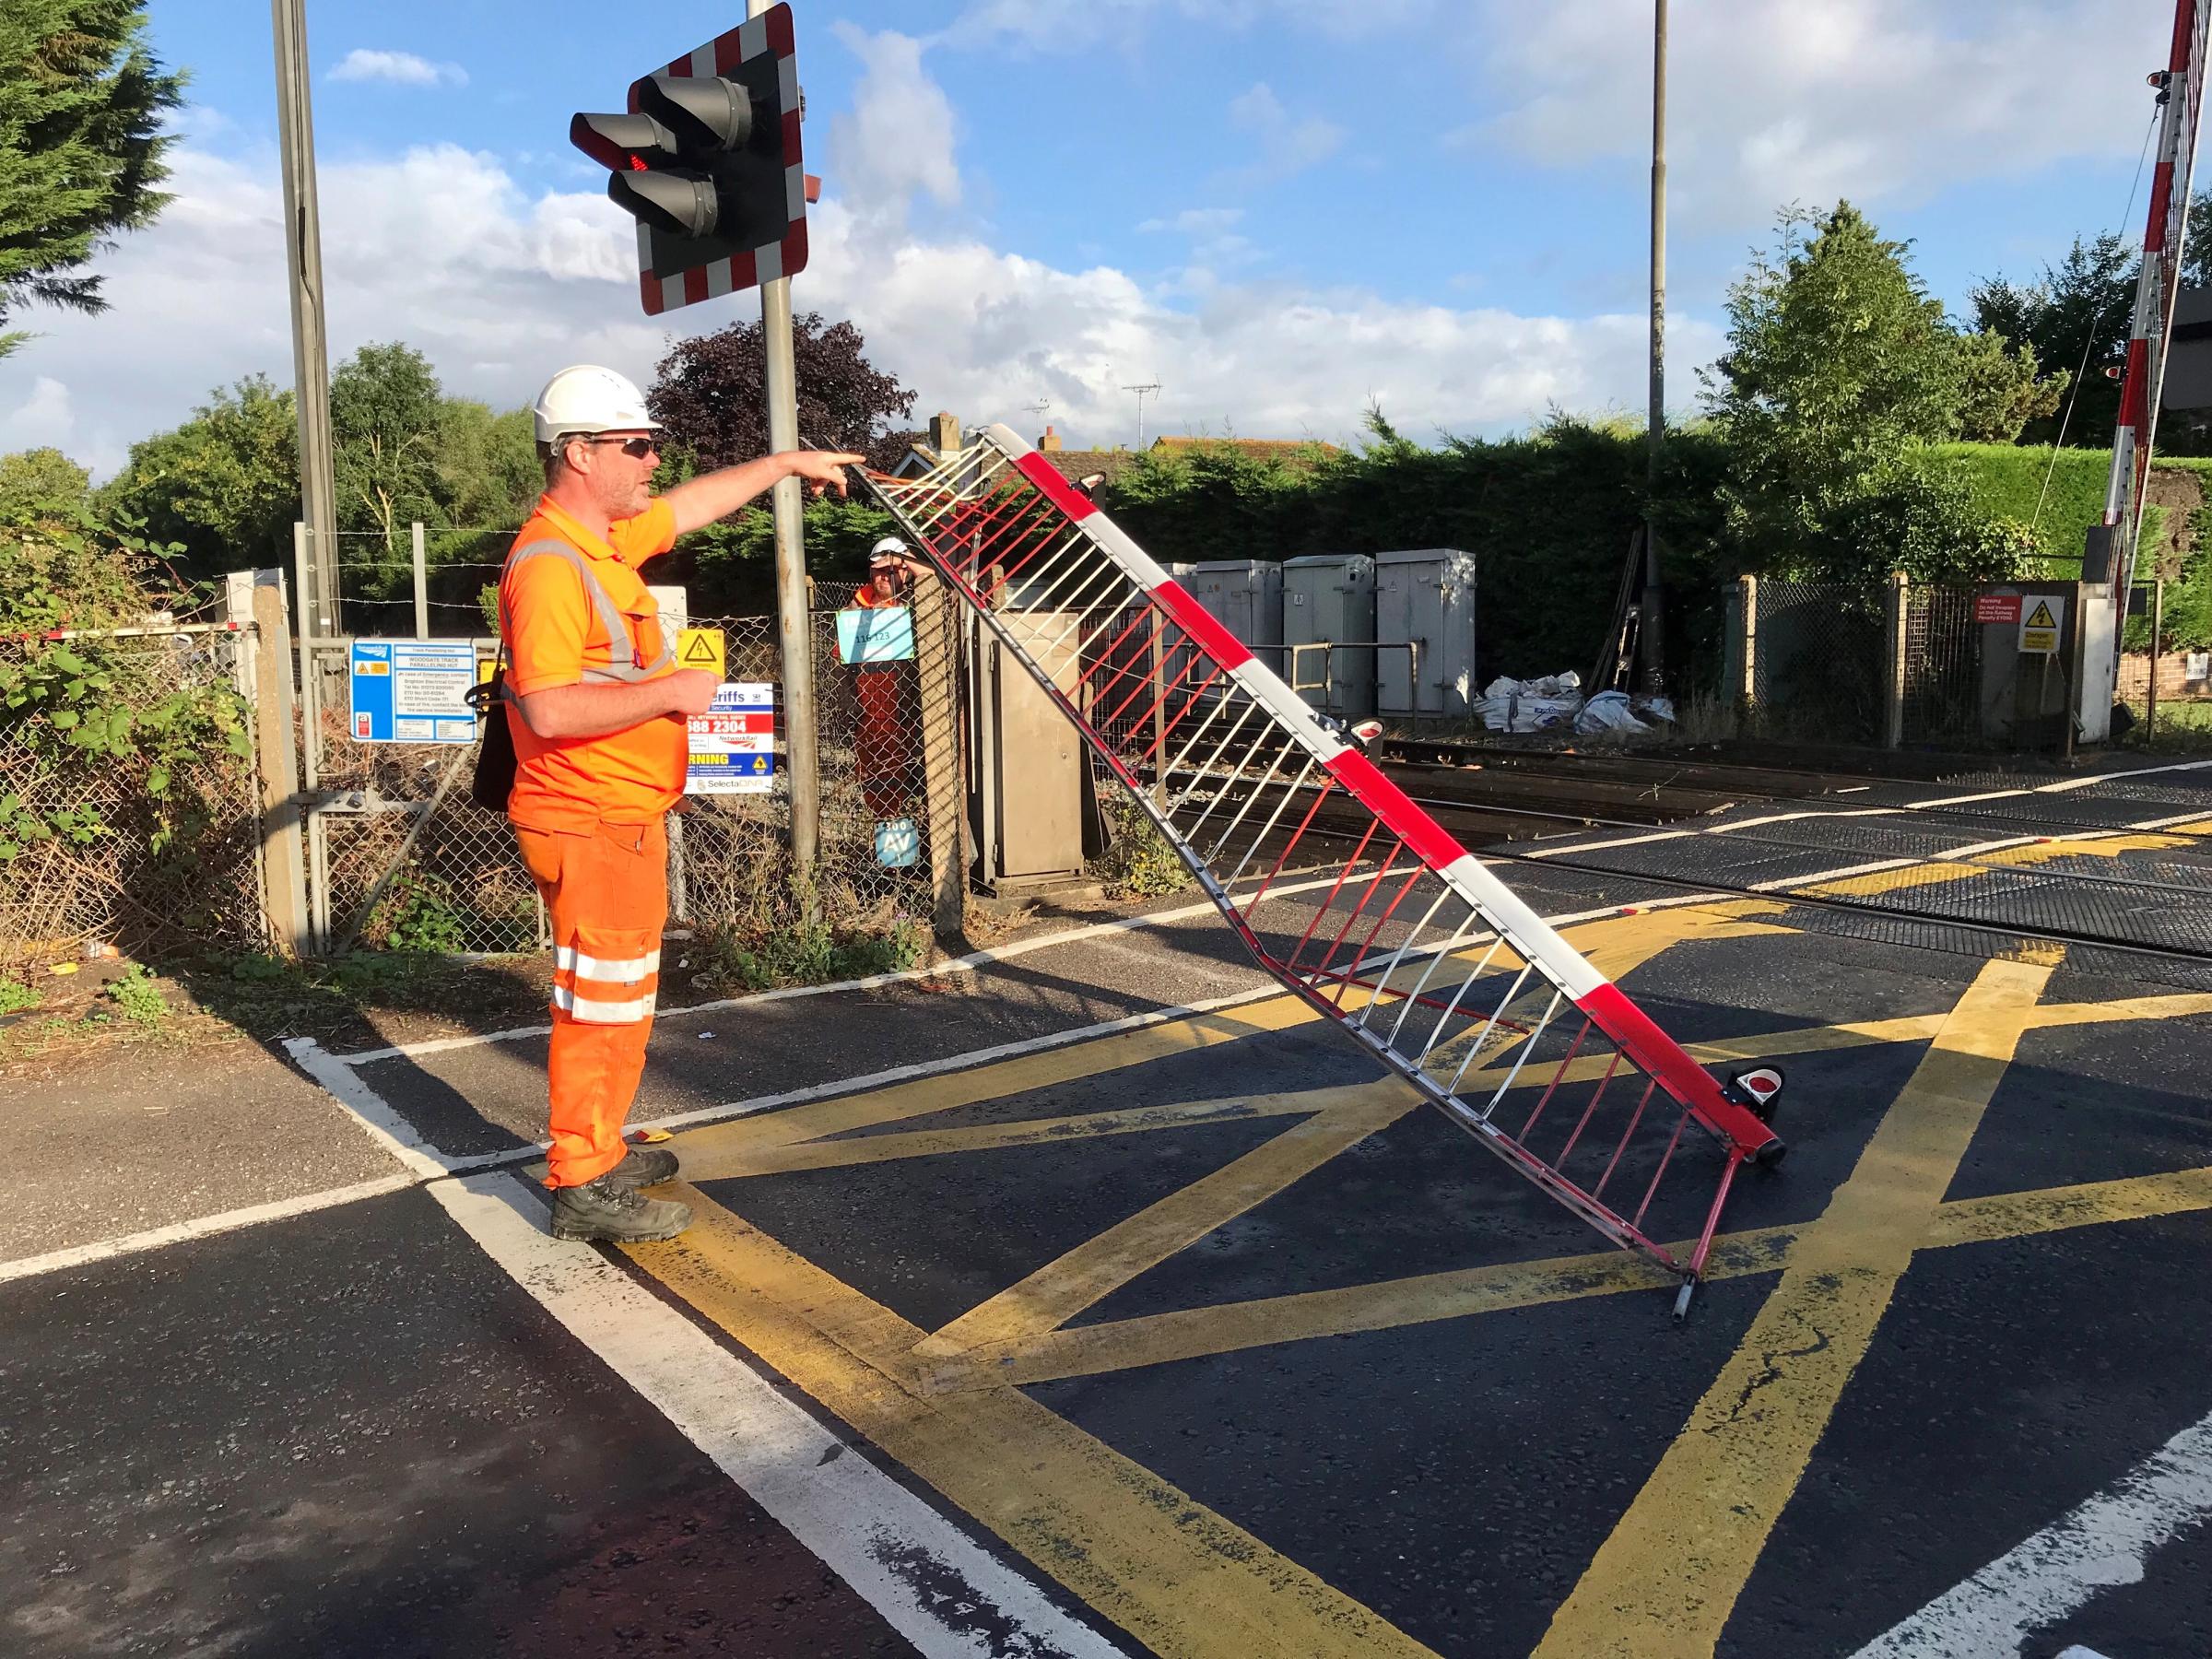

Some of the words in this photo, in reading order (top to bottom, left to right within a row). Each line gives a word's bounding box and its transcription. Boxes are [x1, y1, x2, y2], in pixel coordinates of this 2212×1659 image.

[855, 633, 872, 643] 116
[875, 631, 890, 641] 123
[712, 691, 745, 702] eriffs
[712, 721, 747, 733] 2304
[688, 754, 729, 764] RNING
[885, 821, 907, 831] 300
[884, 832, 911, 853] AV
